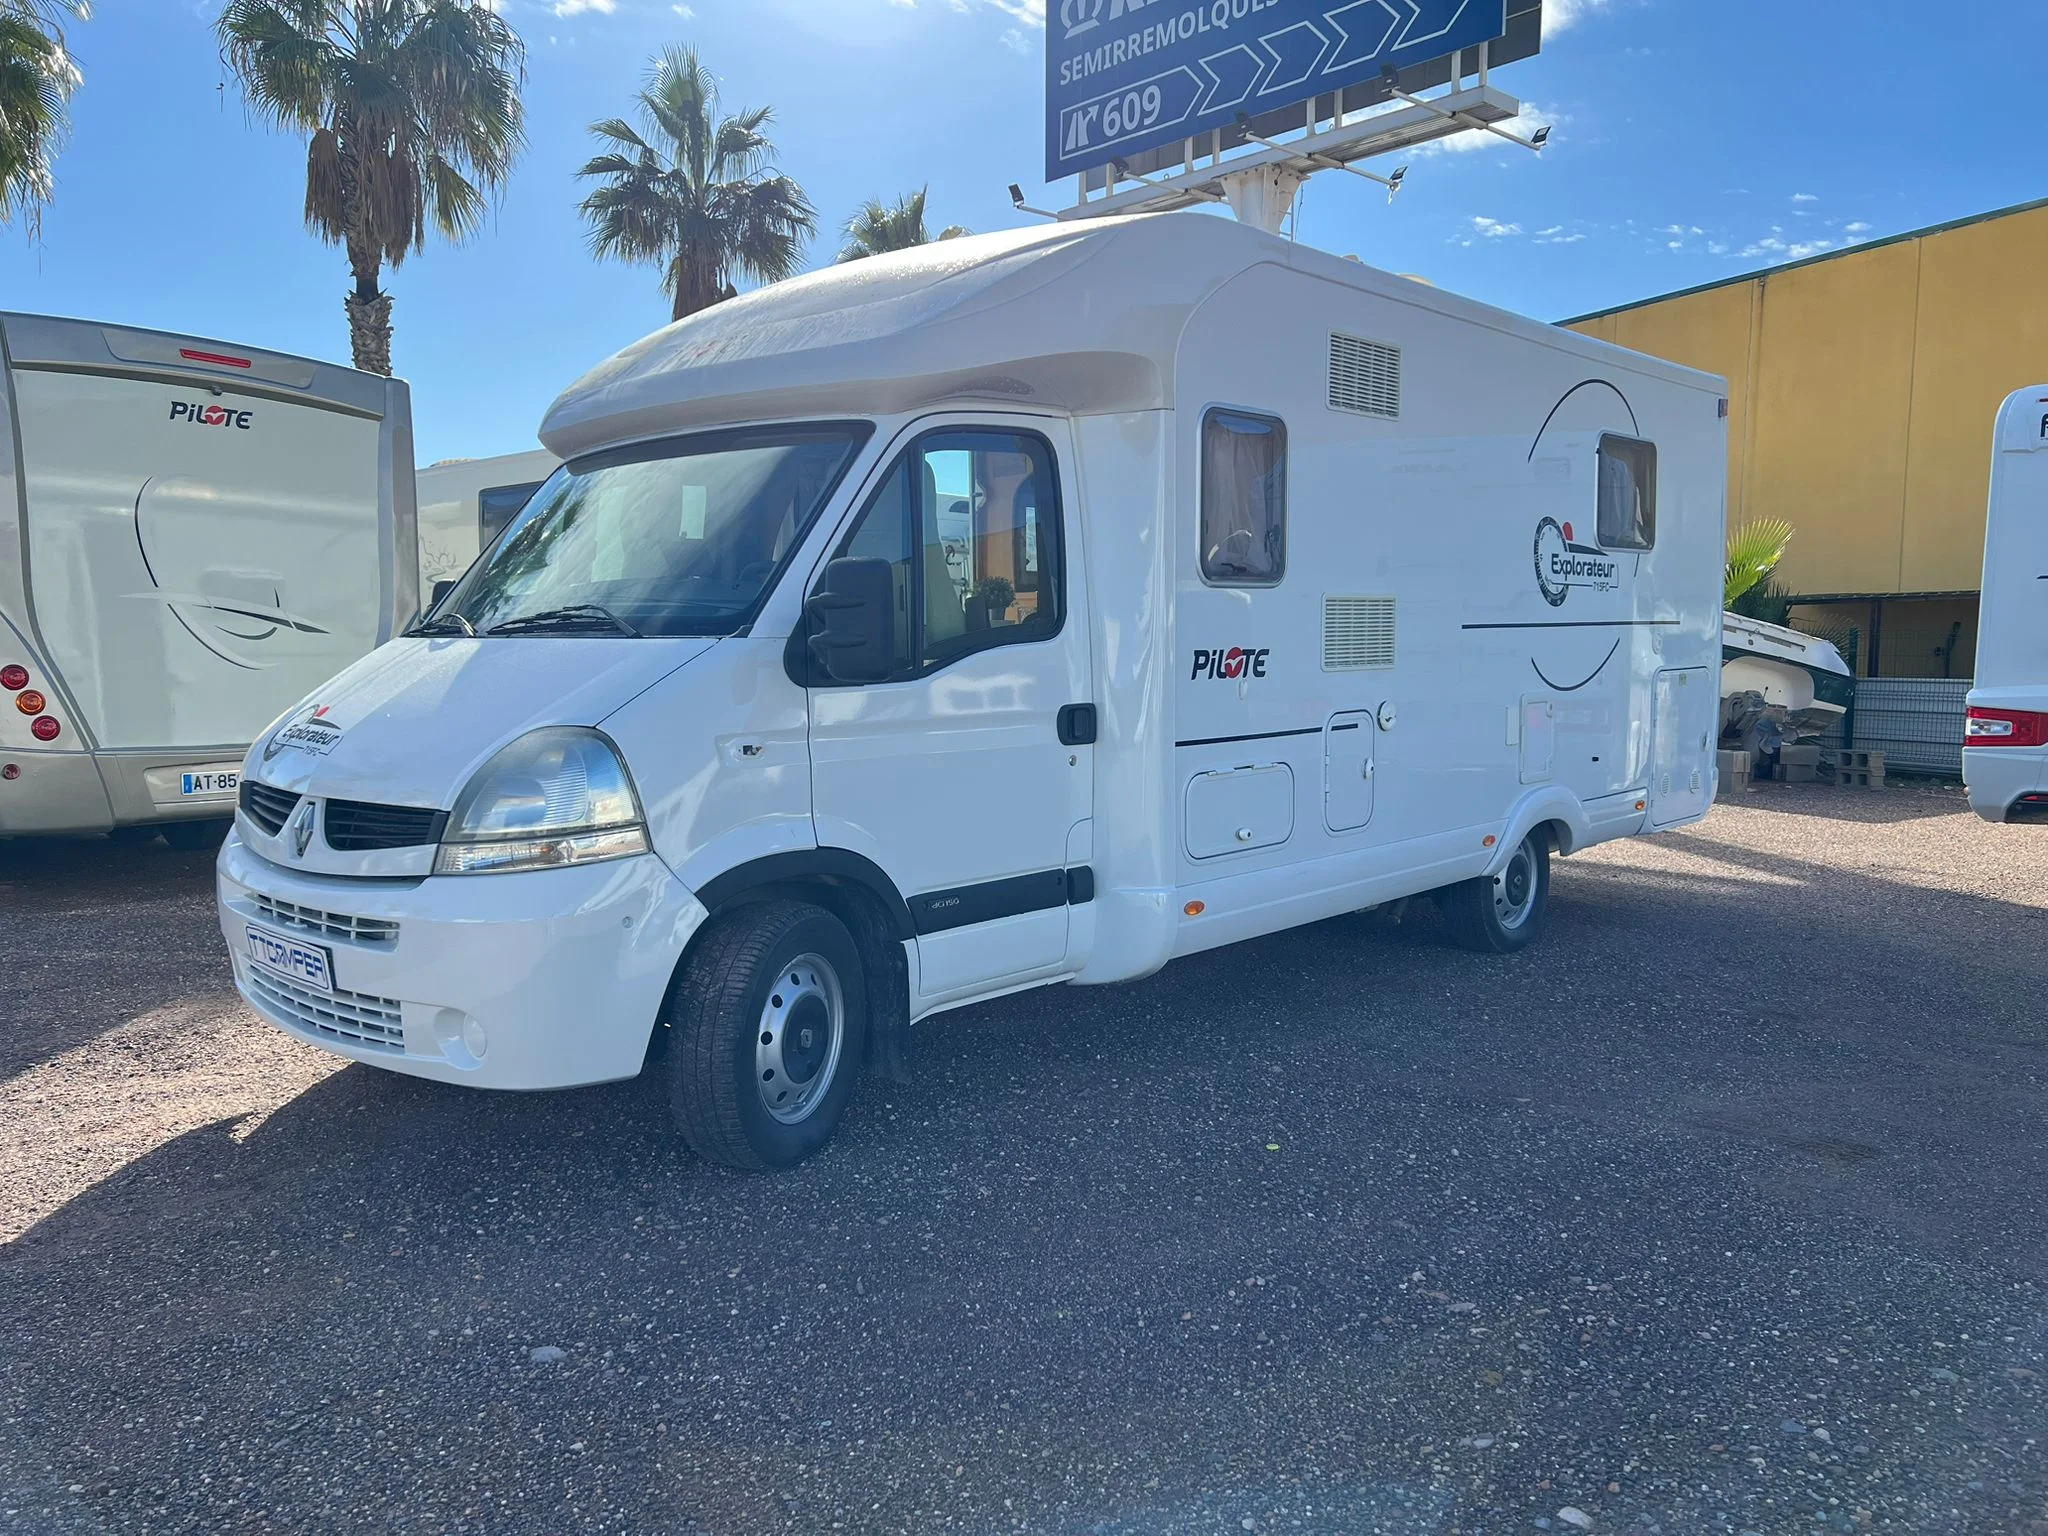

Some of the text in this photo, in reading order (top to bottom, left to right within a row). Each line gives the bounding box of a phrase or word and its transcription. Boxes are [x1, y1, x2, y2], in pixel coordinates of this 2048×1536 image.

[1060, 0, 1279, 86] SEMIRREMOLQU
[1103, 85, 1161, 137] 609
[1551, 553, 1615, 580] Explorateur
[282, 723, 340, 745] Explorateur
[194, 774, 239, 790] AT-85
